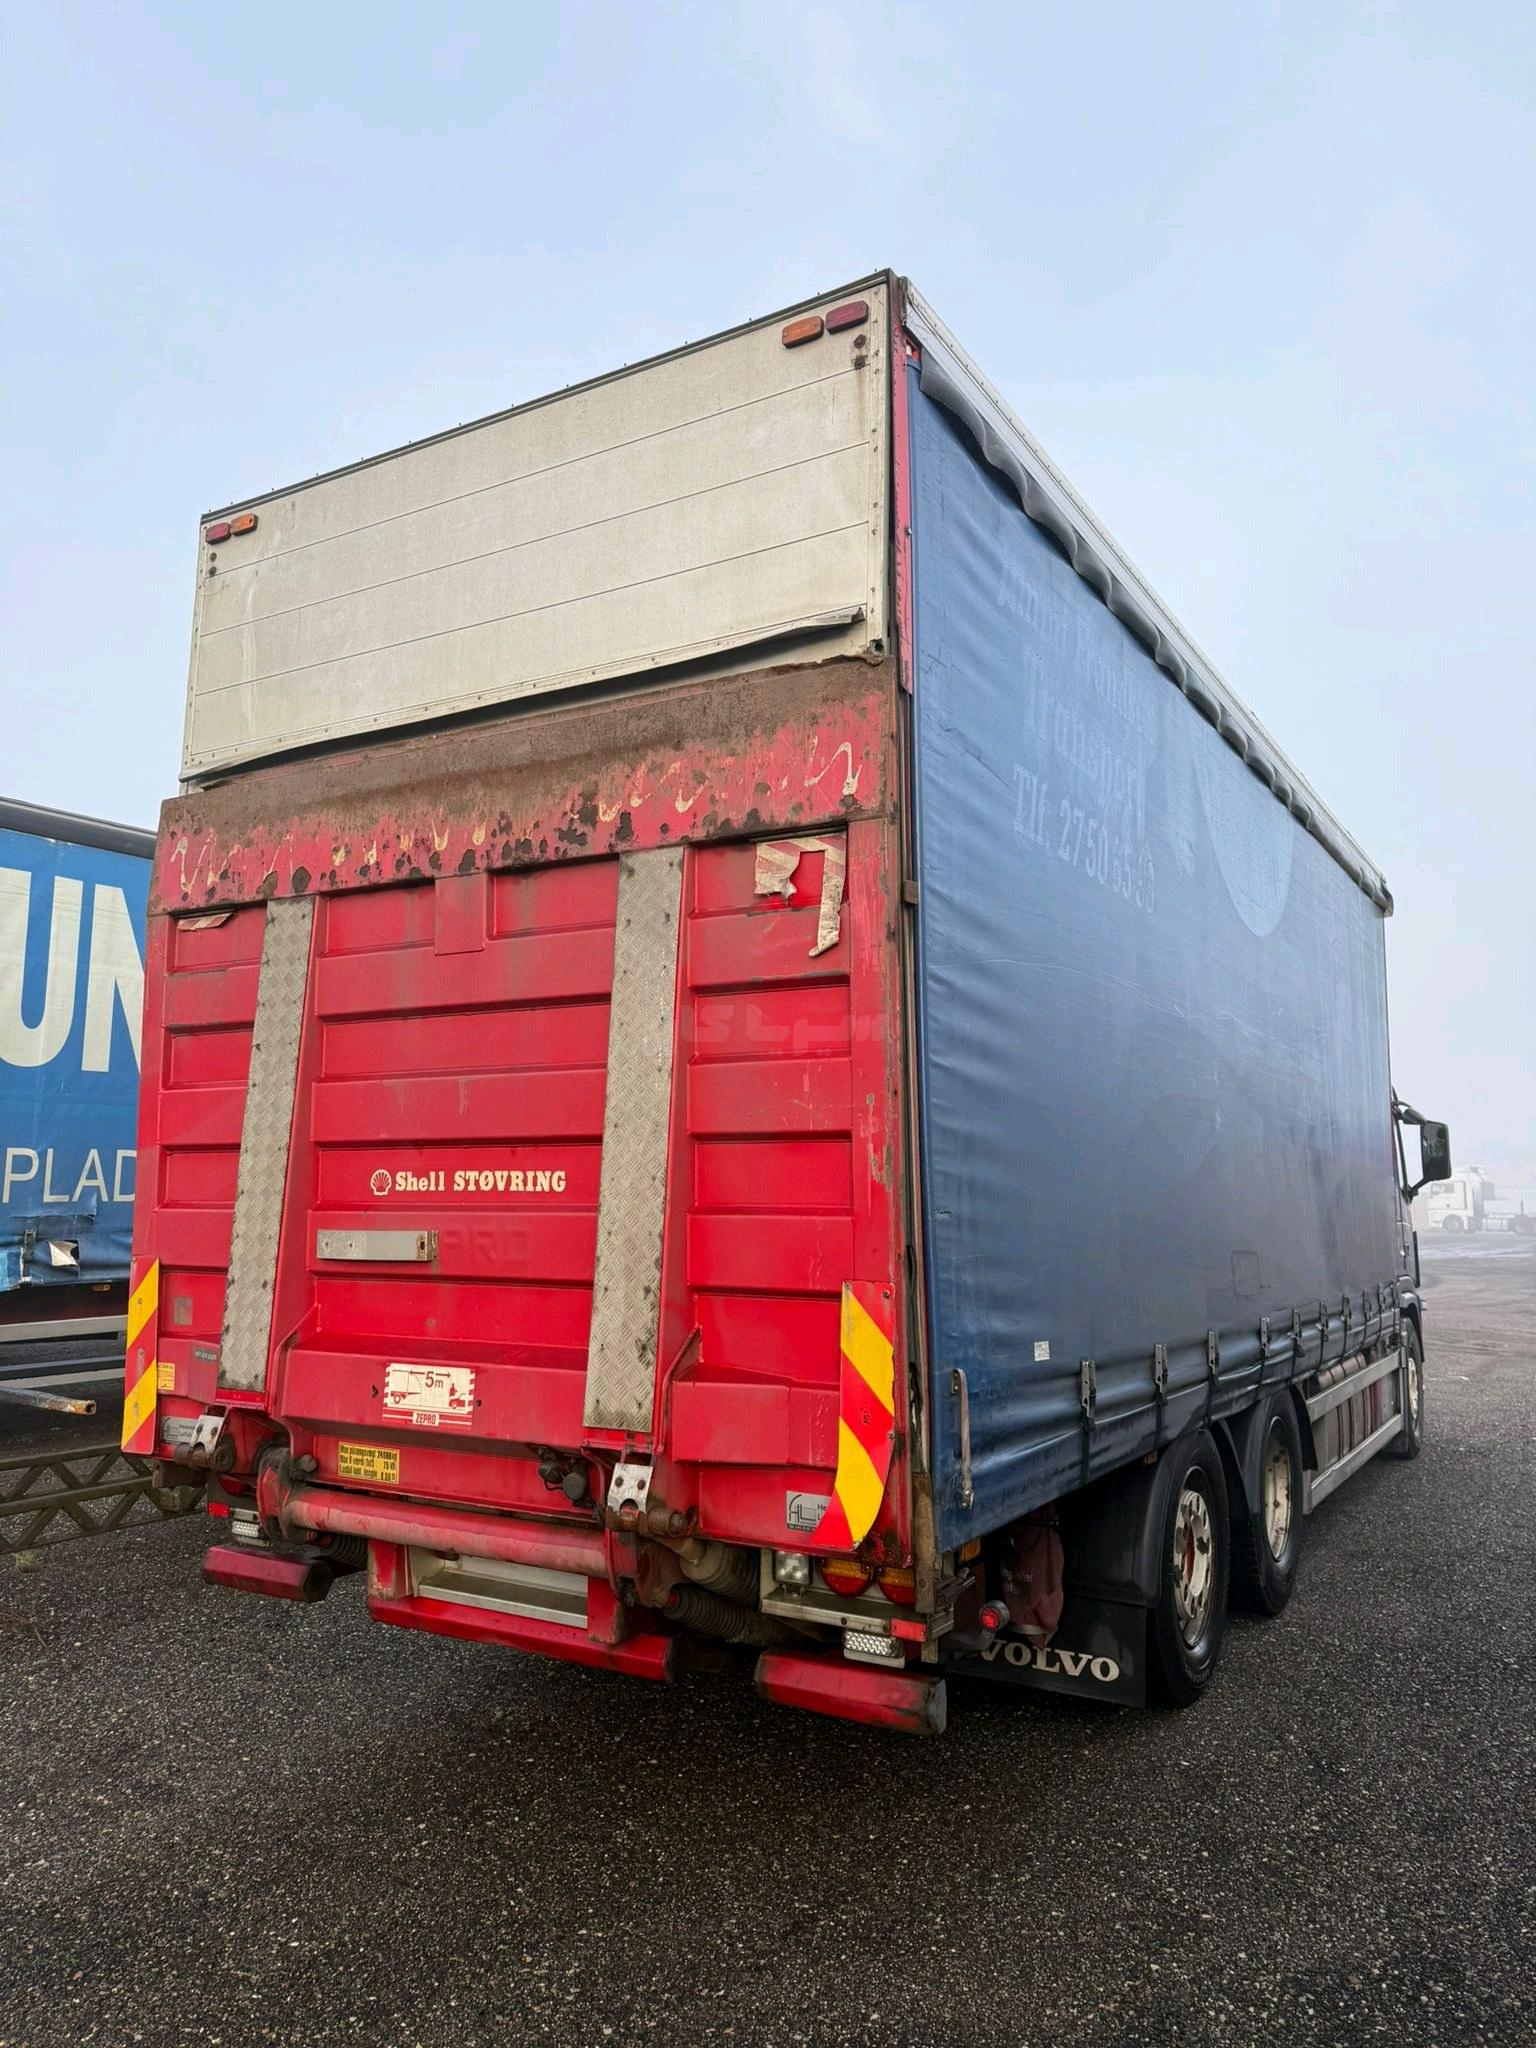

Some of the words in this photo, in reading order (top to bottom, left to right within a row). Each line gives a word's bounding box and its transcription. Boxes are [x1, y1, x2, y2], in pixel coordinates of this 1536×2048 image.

[395, 1171, 445, 1191] Shell
[454, 1170, 567, 1193] STØVRING
[415, 1413, 437, 1425] ZEPRO
[981, 1639, 1120, 1682] VOLVO
